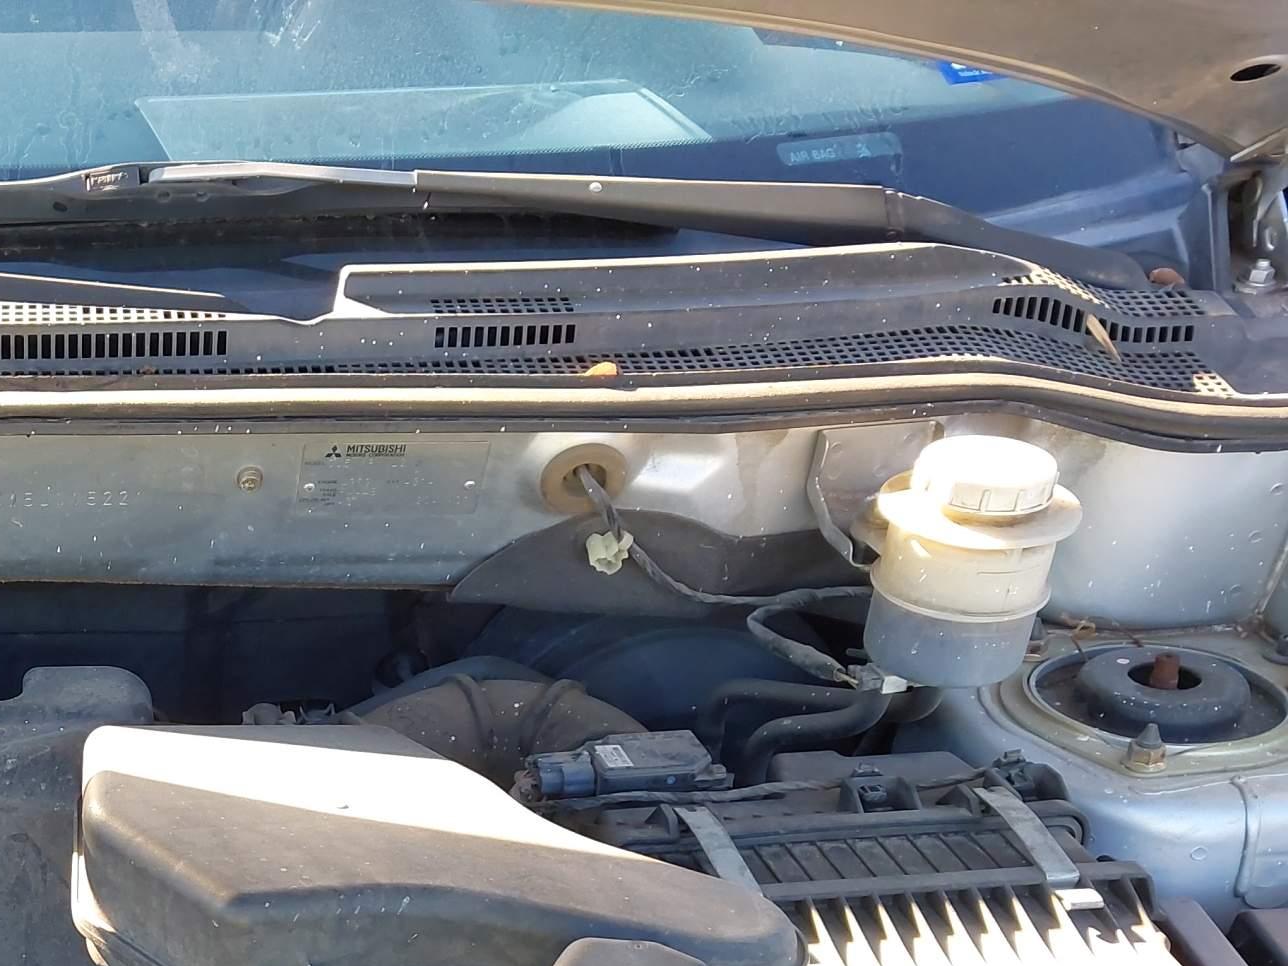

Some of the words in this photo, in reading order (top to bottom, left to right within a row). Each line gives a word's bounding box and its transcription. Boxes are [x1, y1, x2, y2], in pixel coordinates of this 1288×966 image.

[790, 150, 810, 162] AIR
[813, 147, 836, 160] BAG
[346, 443, 407, 454] MITSUBISHI
